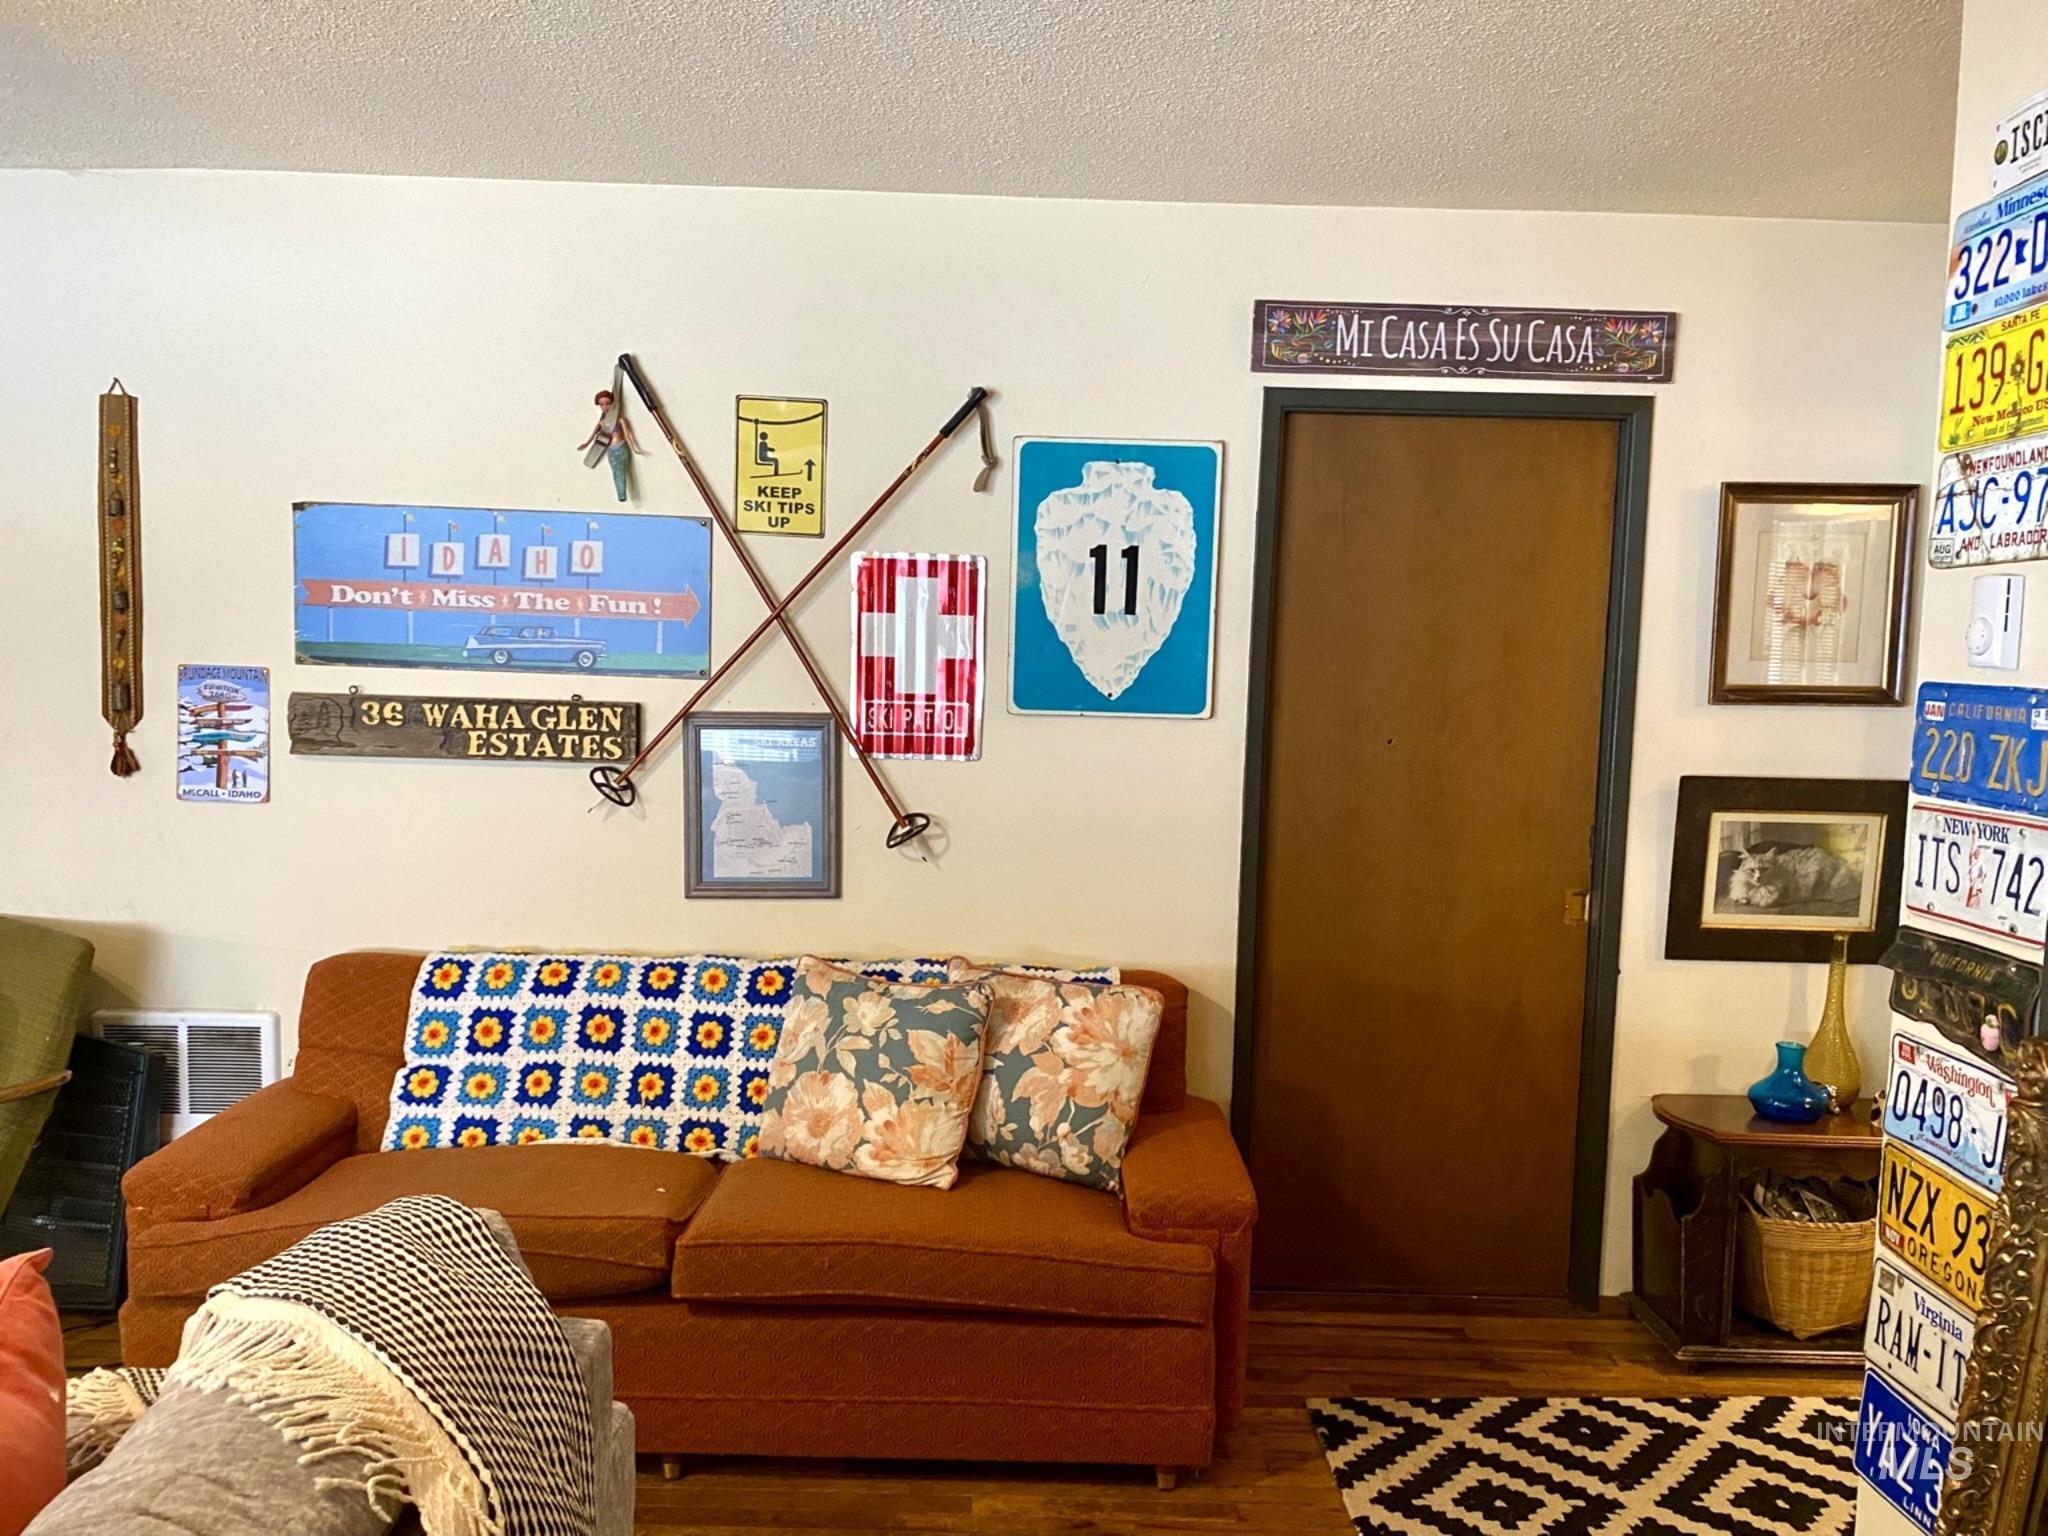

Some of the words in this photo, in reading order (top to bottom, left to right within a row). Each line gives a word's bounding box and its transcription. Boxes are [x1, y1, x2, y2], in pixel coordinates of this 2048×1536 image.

[1954, 228, 2013, 300] 322
[2001, 314, 2027, 331] SANTA
[2030, 309, 2040, 322] FE
[1950, 341, 2006, 415] 139
[2027, 328, 2048, 395] G
[1972, 415, 1993, 427] New
[757, 485, 802, 499] KEEP
[743, 500, 772, 514] SKI
[779, 502, 815, 516] TIPS
[767, 516, 790, 529] UP
[1934, 544, 1951, 554] AUG
[1960, 536, 1981, 551] AND
[1990, 529, 2047, 549] LABRADOR
[1089, 544, 1139, 615] 11
[330, 584, 414, 605] Don't
[431, 588, 496, 609] Miss
[513, 591, 570, 612] The
[868, 708, 893, 729] SKI
[1924, 703, 1944, 718] JAN
[1949, 703, 2026, 723] CALIFORNIA
[467, 730, 623, 760] ESTATES
[1921, 727, 1976, 783] 220
[1987, 734, 2048, 797] ZKJ
[228, 790, 262, 799] IDAHO
[1943, 817, 1972, 837] NEW
[1976, 821, 2010, 844] YORK
[1915, 834, 1961, 895] ITS
[1990, 848, 2044, 917] 742
[1930, 951, 1997, 982] CALIFORNIA
[1926, 1054, 1996, 1108] Washington
[1887, 1160, 1941, 1246] NZX
[1952, 1202, 1991, 1276] 93
[1908, 1237, 1977, 1302] OREGON
[1914, 1292, 1963, 1342] Virginia
[1908, 1413, 1940, 1453] IOWA
[1867, 1403, 1918, 1495] YAZ
[1903, 1496, 1932, 1528] LINN
